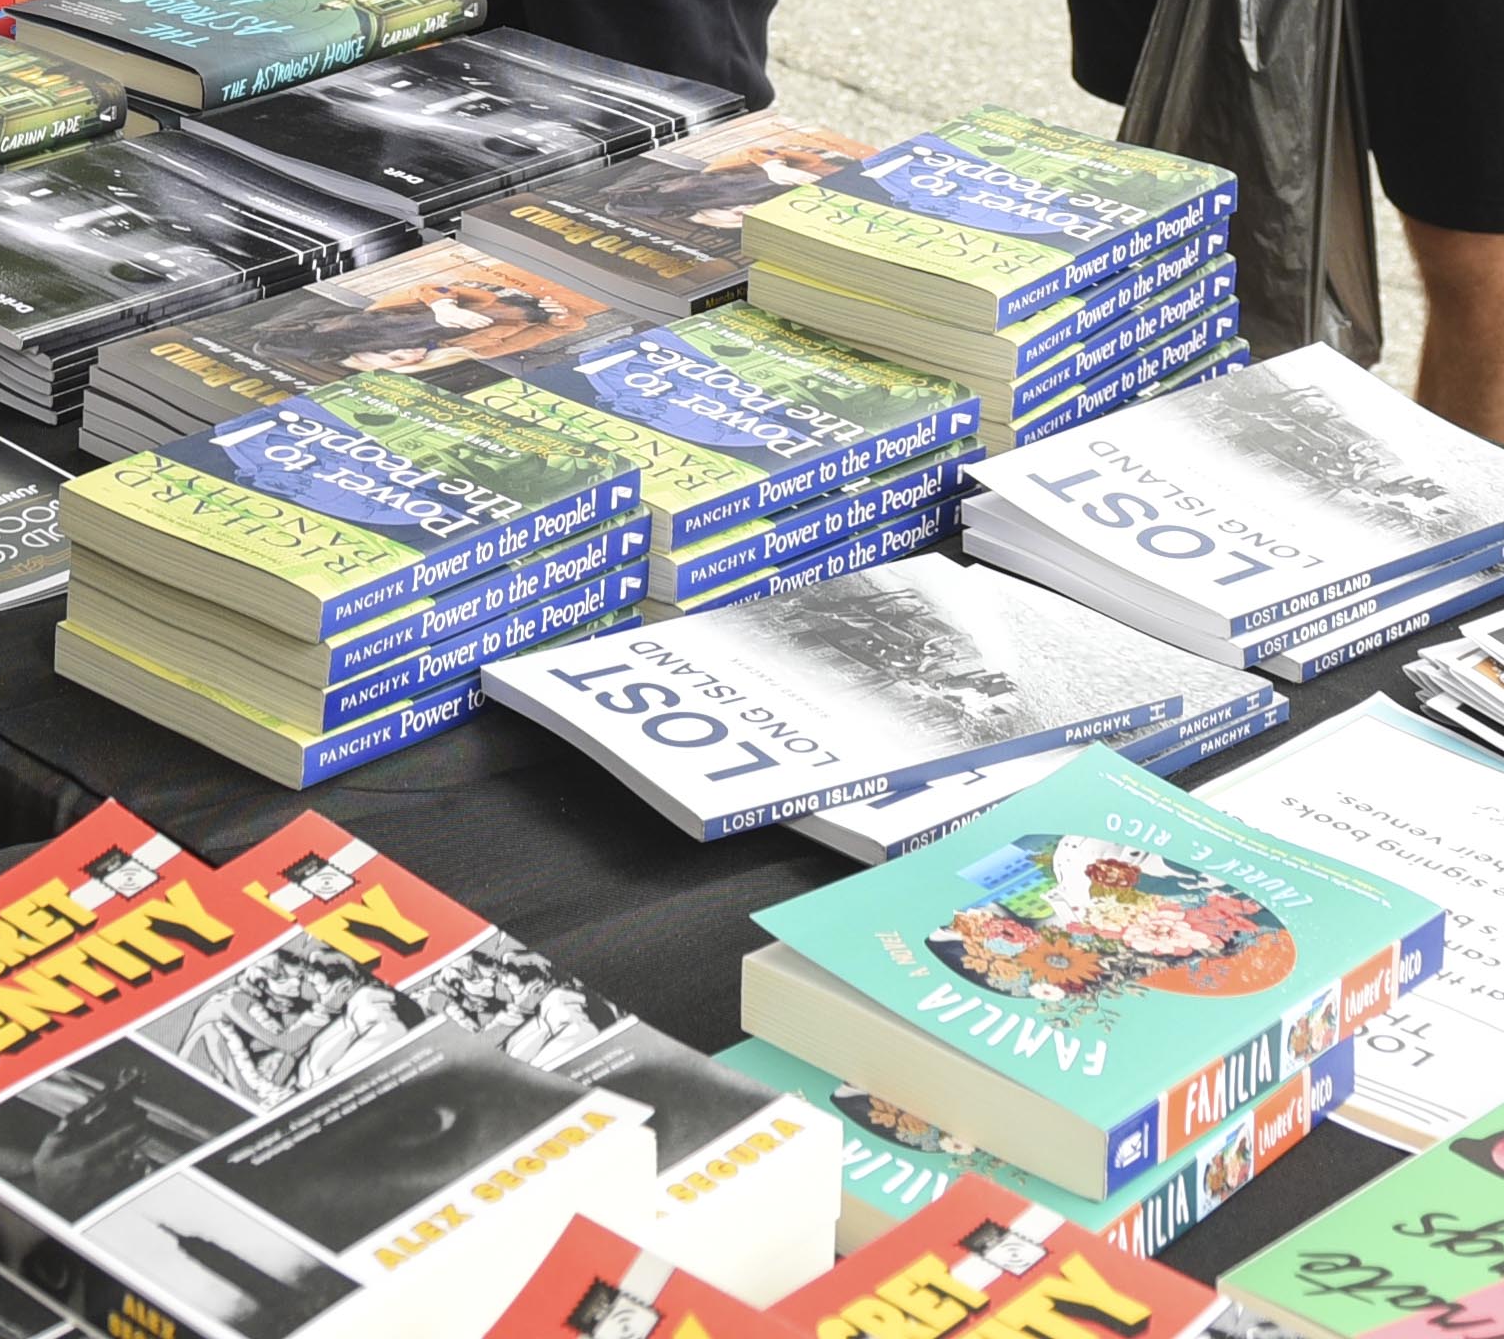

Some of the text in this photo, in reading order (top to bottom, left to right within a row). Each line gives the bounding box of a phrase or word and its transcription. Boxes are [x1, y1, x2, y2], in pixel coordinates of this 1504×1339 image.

[221, 11, 450, 101] THE ASTROLOGY HOUSE CARINN JADE
[0, 126, 46, 154] CARINN
[50, 114, 82, 138] JADE
[591, 236, 632, 254] TO
[1007, 196, 1204, 316] PANCHYK Power to the People!
[114, 468, 362, 576] RICHARD
[146, 450, 390, 566] PANCHYK
[264, 443, 482, 540] Power to
[432, 474, 524, 521] the
[685, 413, 937, 532] PANCHYK Power to the People!
[335, 488, 597, 623] PANCHYK Power to the People!
[344, 534, 607, 669] PANCHYK Power to the People!
[1244, 601, 1279, 631] LOST
[1282, 587, 1320, 618] LONG
[1322, 572, 1372, 603] ISLAND
[548, 663, 782, 783] LOST
[626, 638, 841, 769] LONG ISLAND
[721, 714, 1133, 833] LOST LONG ISLAND PANCHYK
[1279, 795, 1372, 847] books
[1335, 790, 1442, 851] venues.
[1105, 812, 1315, 908] LAUREN E. RICO
[1375, 839, 1489, 892] signing
[917, 981, 1109, 1078] FAMILIA
[1184, 1033, 1274, 1136] FAMILIA
[1398, 948, 1423, 983] RICO
[372, 1200, 472, 1273] ALEX
[470, 1107, 619, 1208] SEGURA
